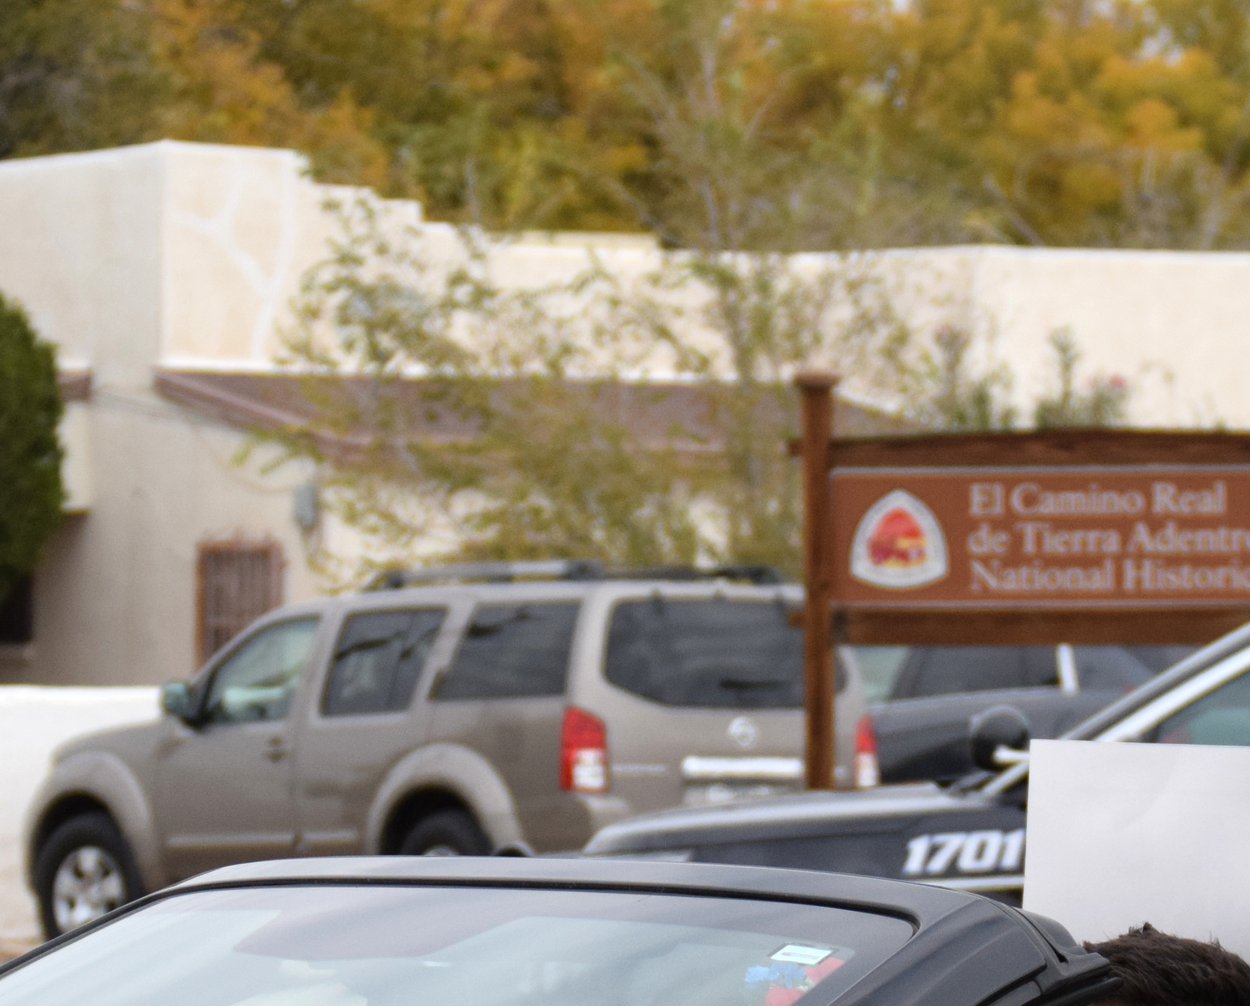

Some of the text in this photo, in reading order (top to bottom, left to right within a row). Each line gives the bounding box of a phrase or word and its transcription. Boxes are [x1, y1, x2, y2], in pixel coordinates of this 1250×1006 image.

[969, 480, 1226, 517] El Camino Real
[967, 522, 1008, 553] de
[1016, 521, 1119, 553] Tierra
[970, 560, 1114, 592] National
[902, 829, 1026, 875] 1701
